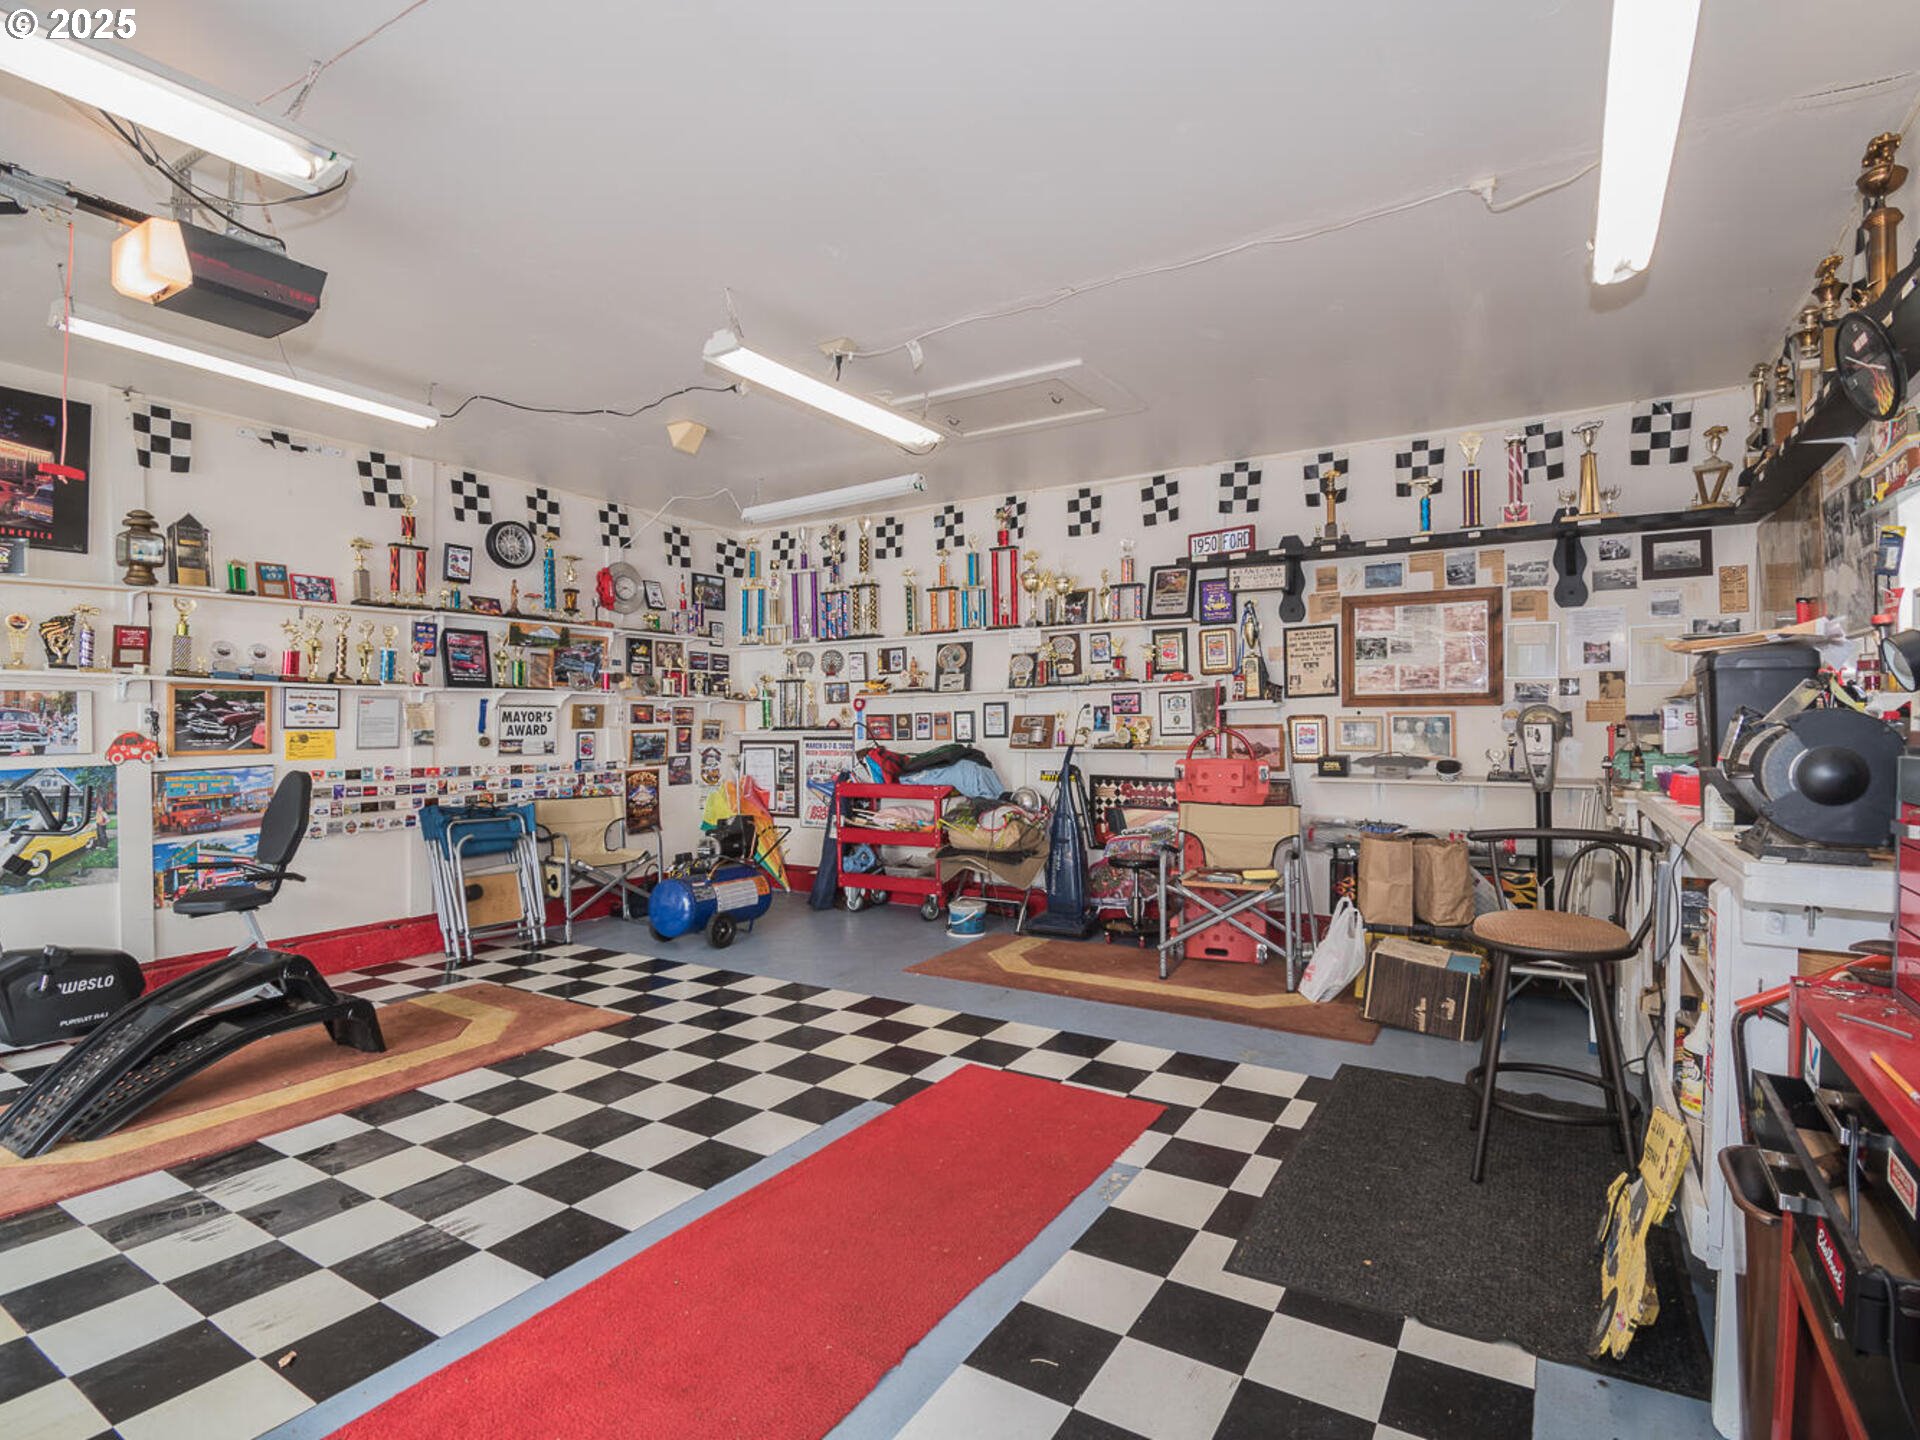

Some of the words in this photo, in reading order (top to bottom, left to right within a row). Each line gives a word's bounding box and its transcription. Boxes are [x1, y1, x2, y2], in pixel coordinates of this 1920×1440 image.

[1193, 536, 1217, 553] 1950
[1222, 531, 1250, 549] FORD
[501, 711, 553, 723] MAYOR'S
[506, 725, 548, 736] AWARD
